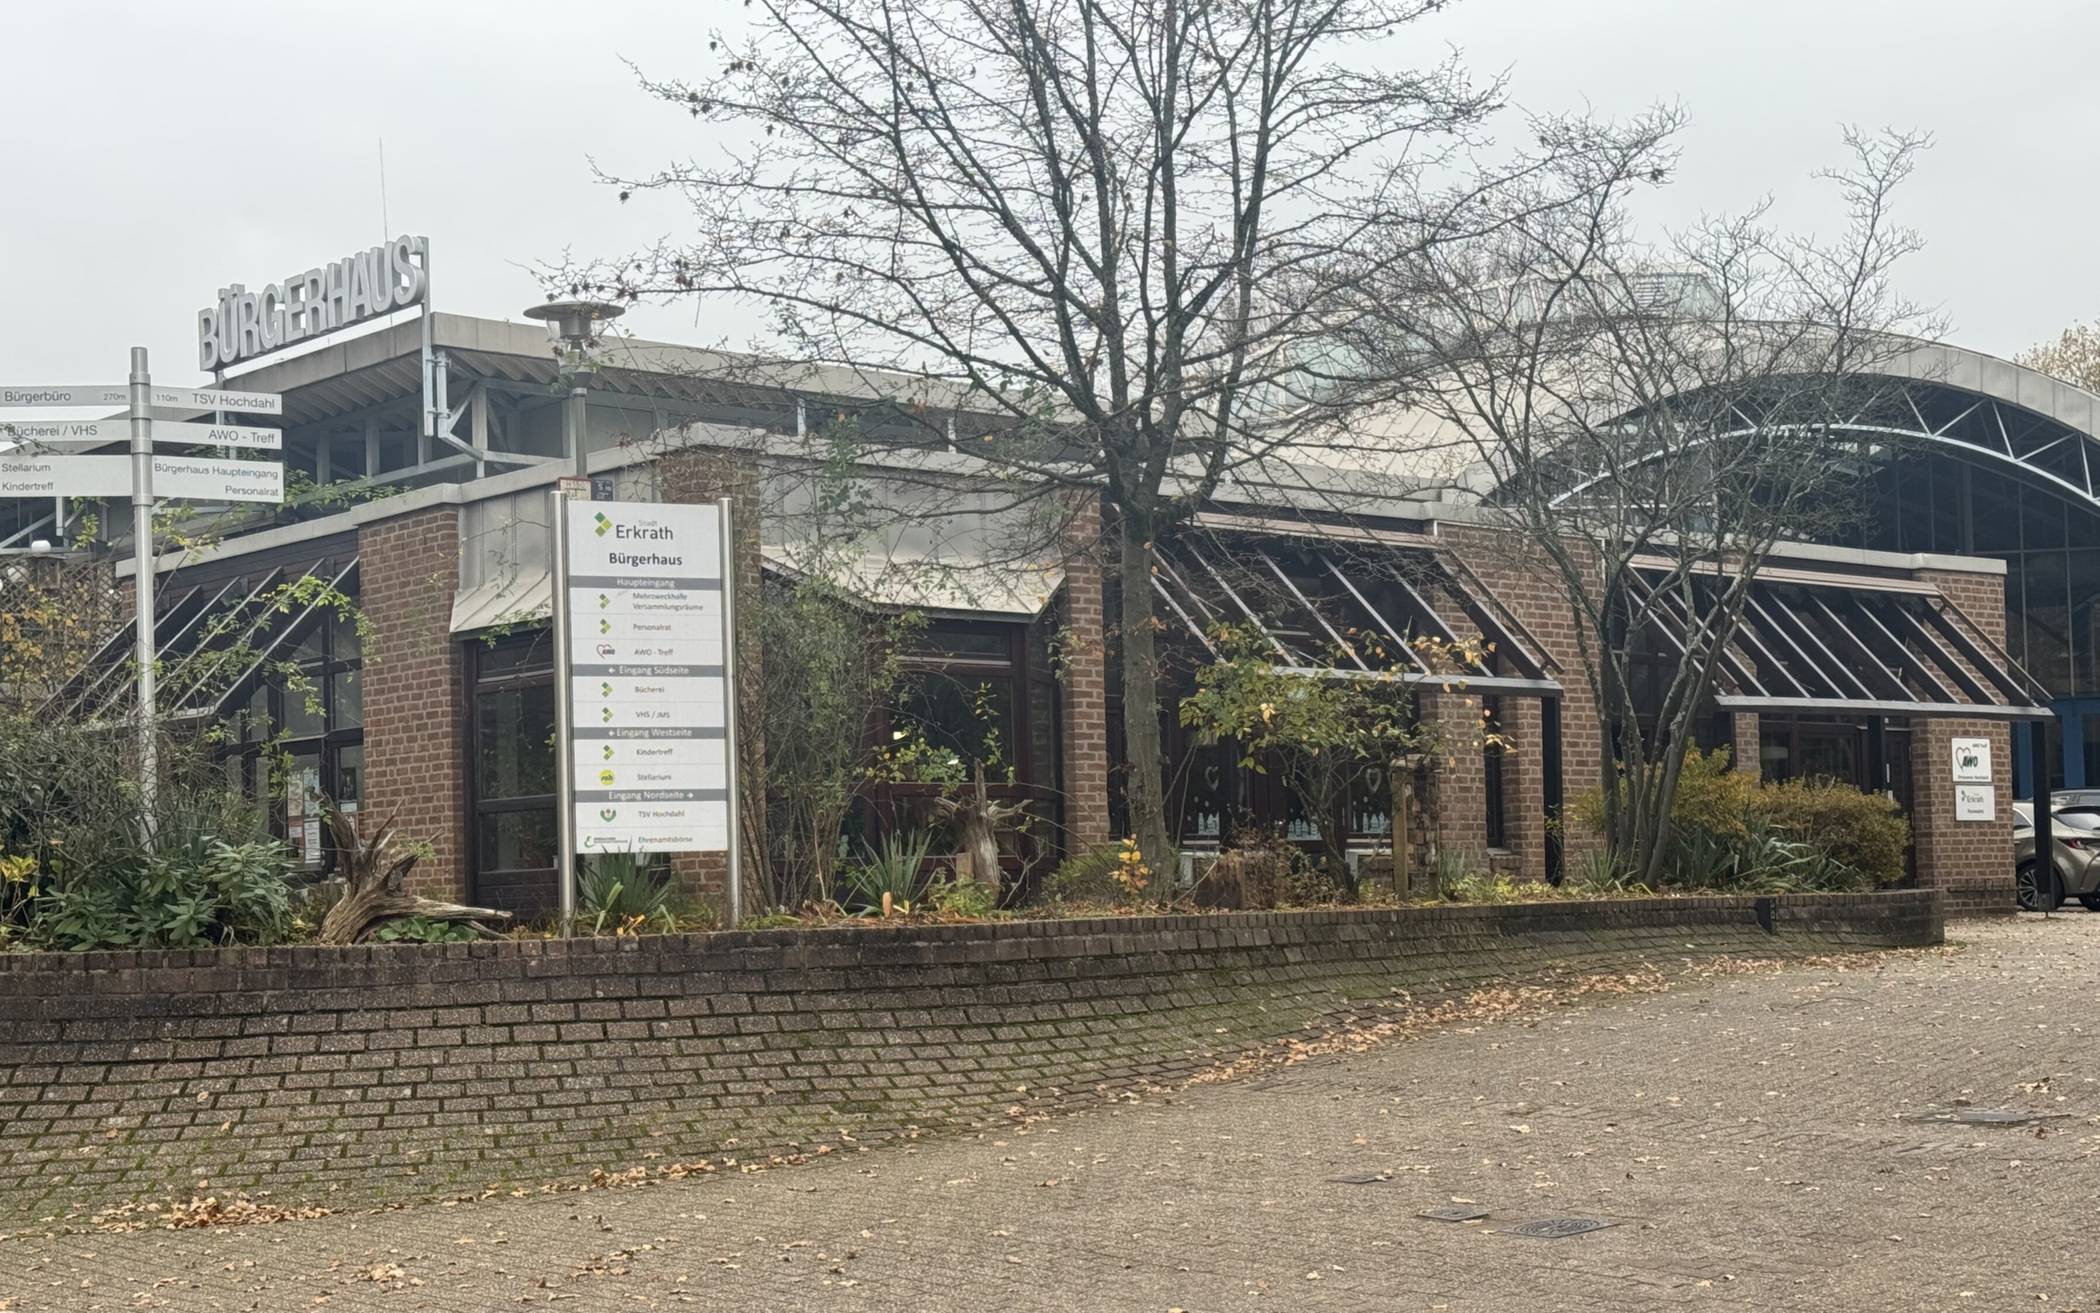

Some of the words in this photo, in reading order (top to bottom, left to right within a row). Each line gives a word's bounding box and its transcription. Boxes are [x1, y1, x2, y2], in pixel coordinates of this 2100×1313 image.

[198, 234, 426, 372] BÜRGERHAUS
[4, 391, 71, 402] Bürgerbüro
[103, 393, 127, 401] 270m
[156, 394, 178, 402] 110m
[192, 392, 216, 405] TSV
[219, 395, 275, 409] Hochdahl
[71, 425, 97, 436] VHS
[208, 430, 239, 441] AWO
[251, 432, 275, 443] Treff
[1, 463, 51, 472] Stellarium
[154, 463, 210, 476] Bürgerhaus
[212, 467, 279, 479] Haupteingang
[2, 482, 54, 491] Kindertreff
[225, 486, 279, 496] Personalrat
[616, 525, 674, 540] Erkrath
[609, 553, 682, 567] Bürgerhaus
[617, 578, 675, 588] Haupteingang
[619, 665, 651, 675] Eingang
[616, 728, 649, 739] Eingang
[652, 728, 692, 737] Westseite
[1963, 756, 1978, 767] AWO
[608, 791, 642, 801] Eingang
[644, 791, 684, 800] Nordseite
